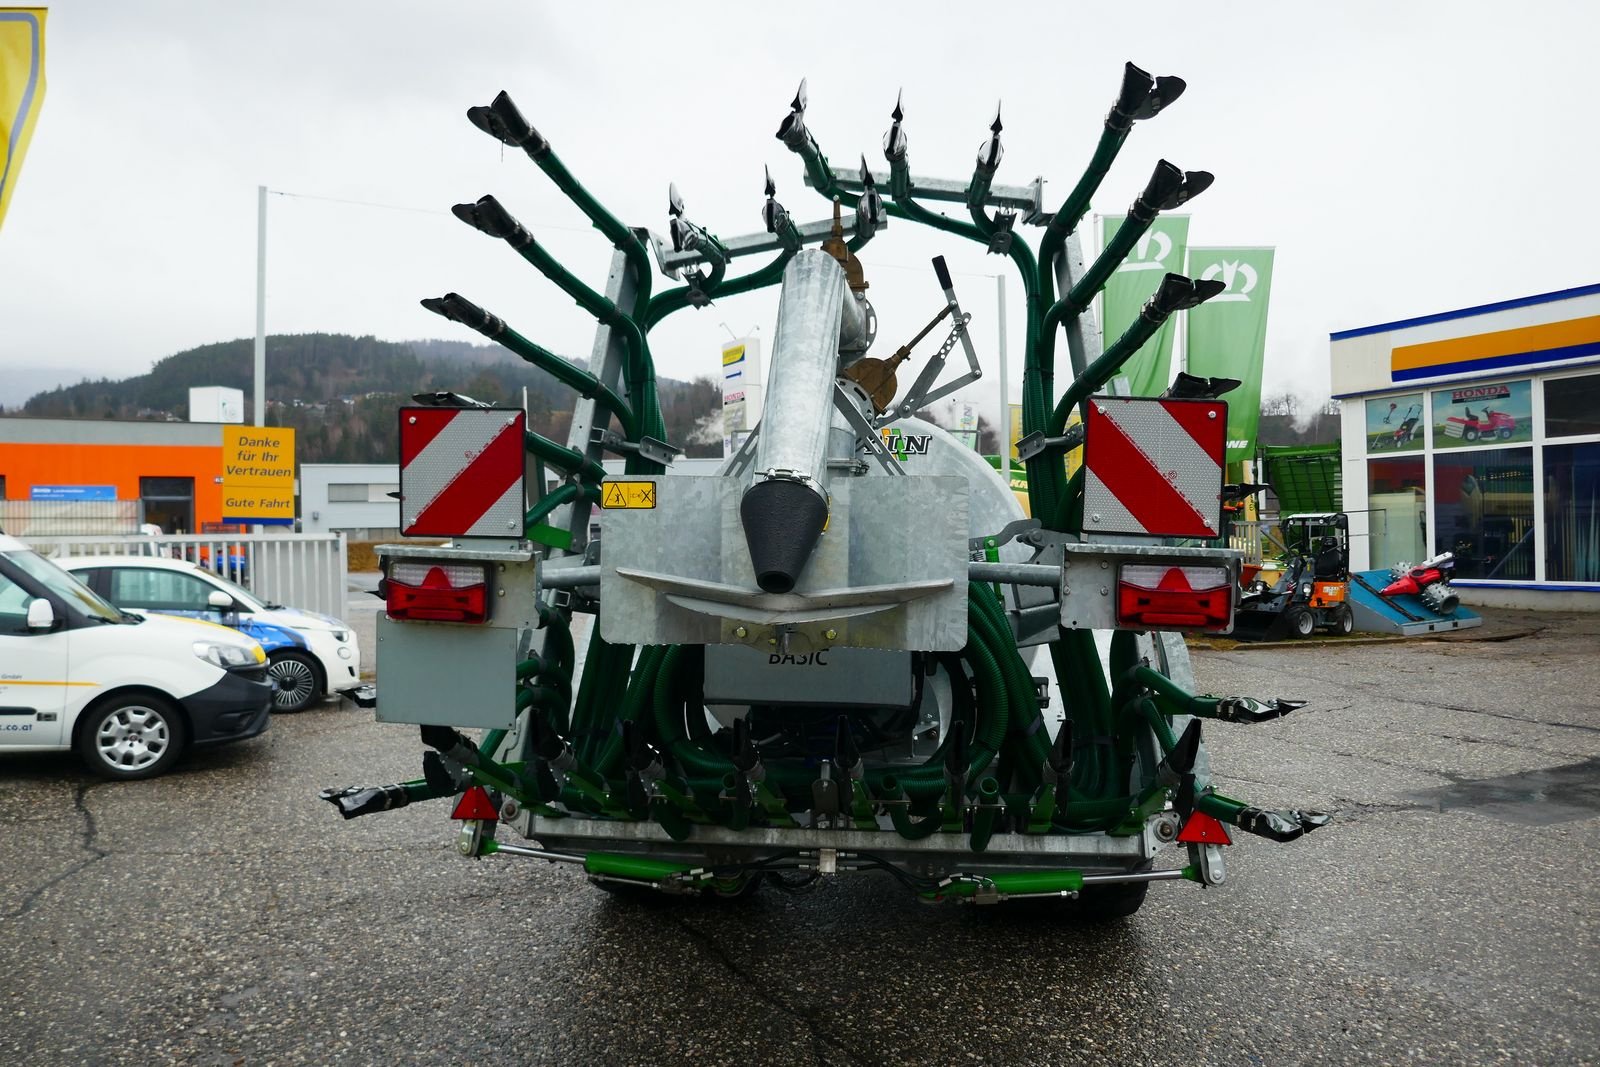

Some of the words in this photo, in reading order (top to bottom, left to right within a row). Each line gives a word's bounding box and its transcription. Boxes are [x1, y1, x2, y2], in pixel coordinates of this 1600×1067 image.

[1452, 385, 1509, 399] HONDA
[239, 436, 280, 448] Danke
[237, 450, 256, 461] für
[262, 452, 279, 462] Ihr
[226, 465, 292, 477] Vertrauen
[225, 498, 255, 508] Gute
[260, 498, 290, 509] Fahrt
[769, 650, 829, 665] BASIC
